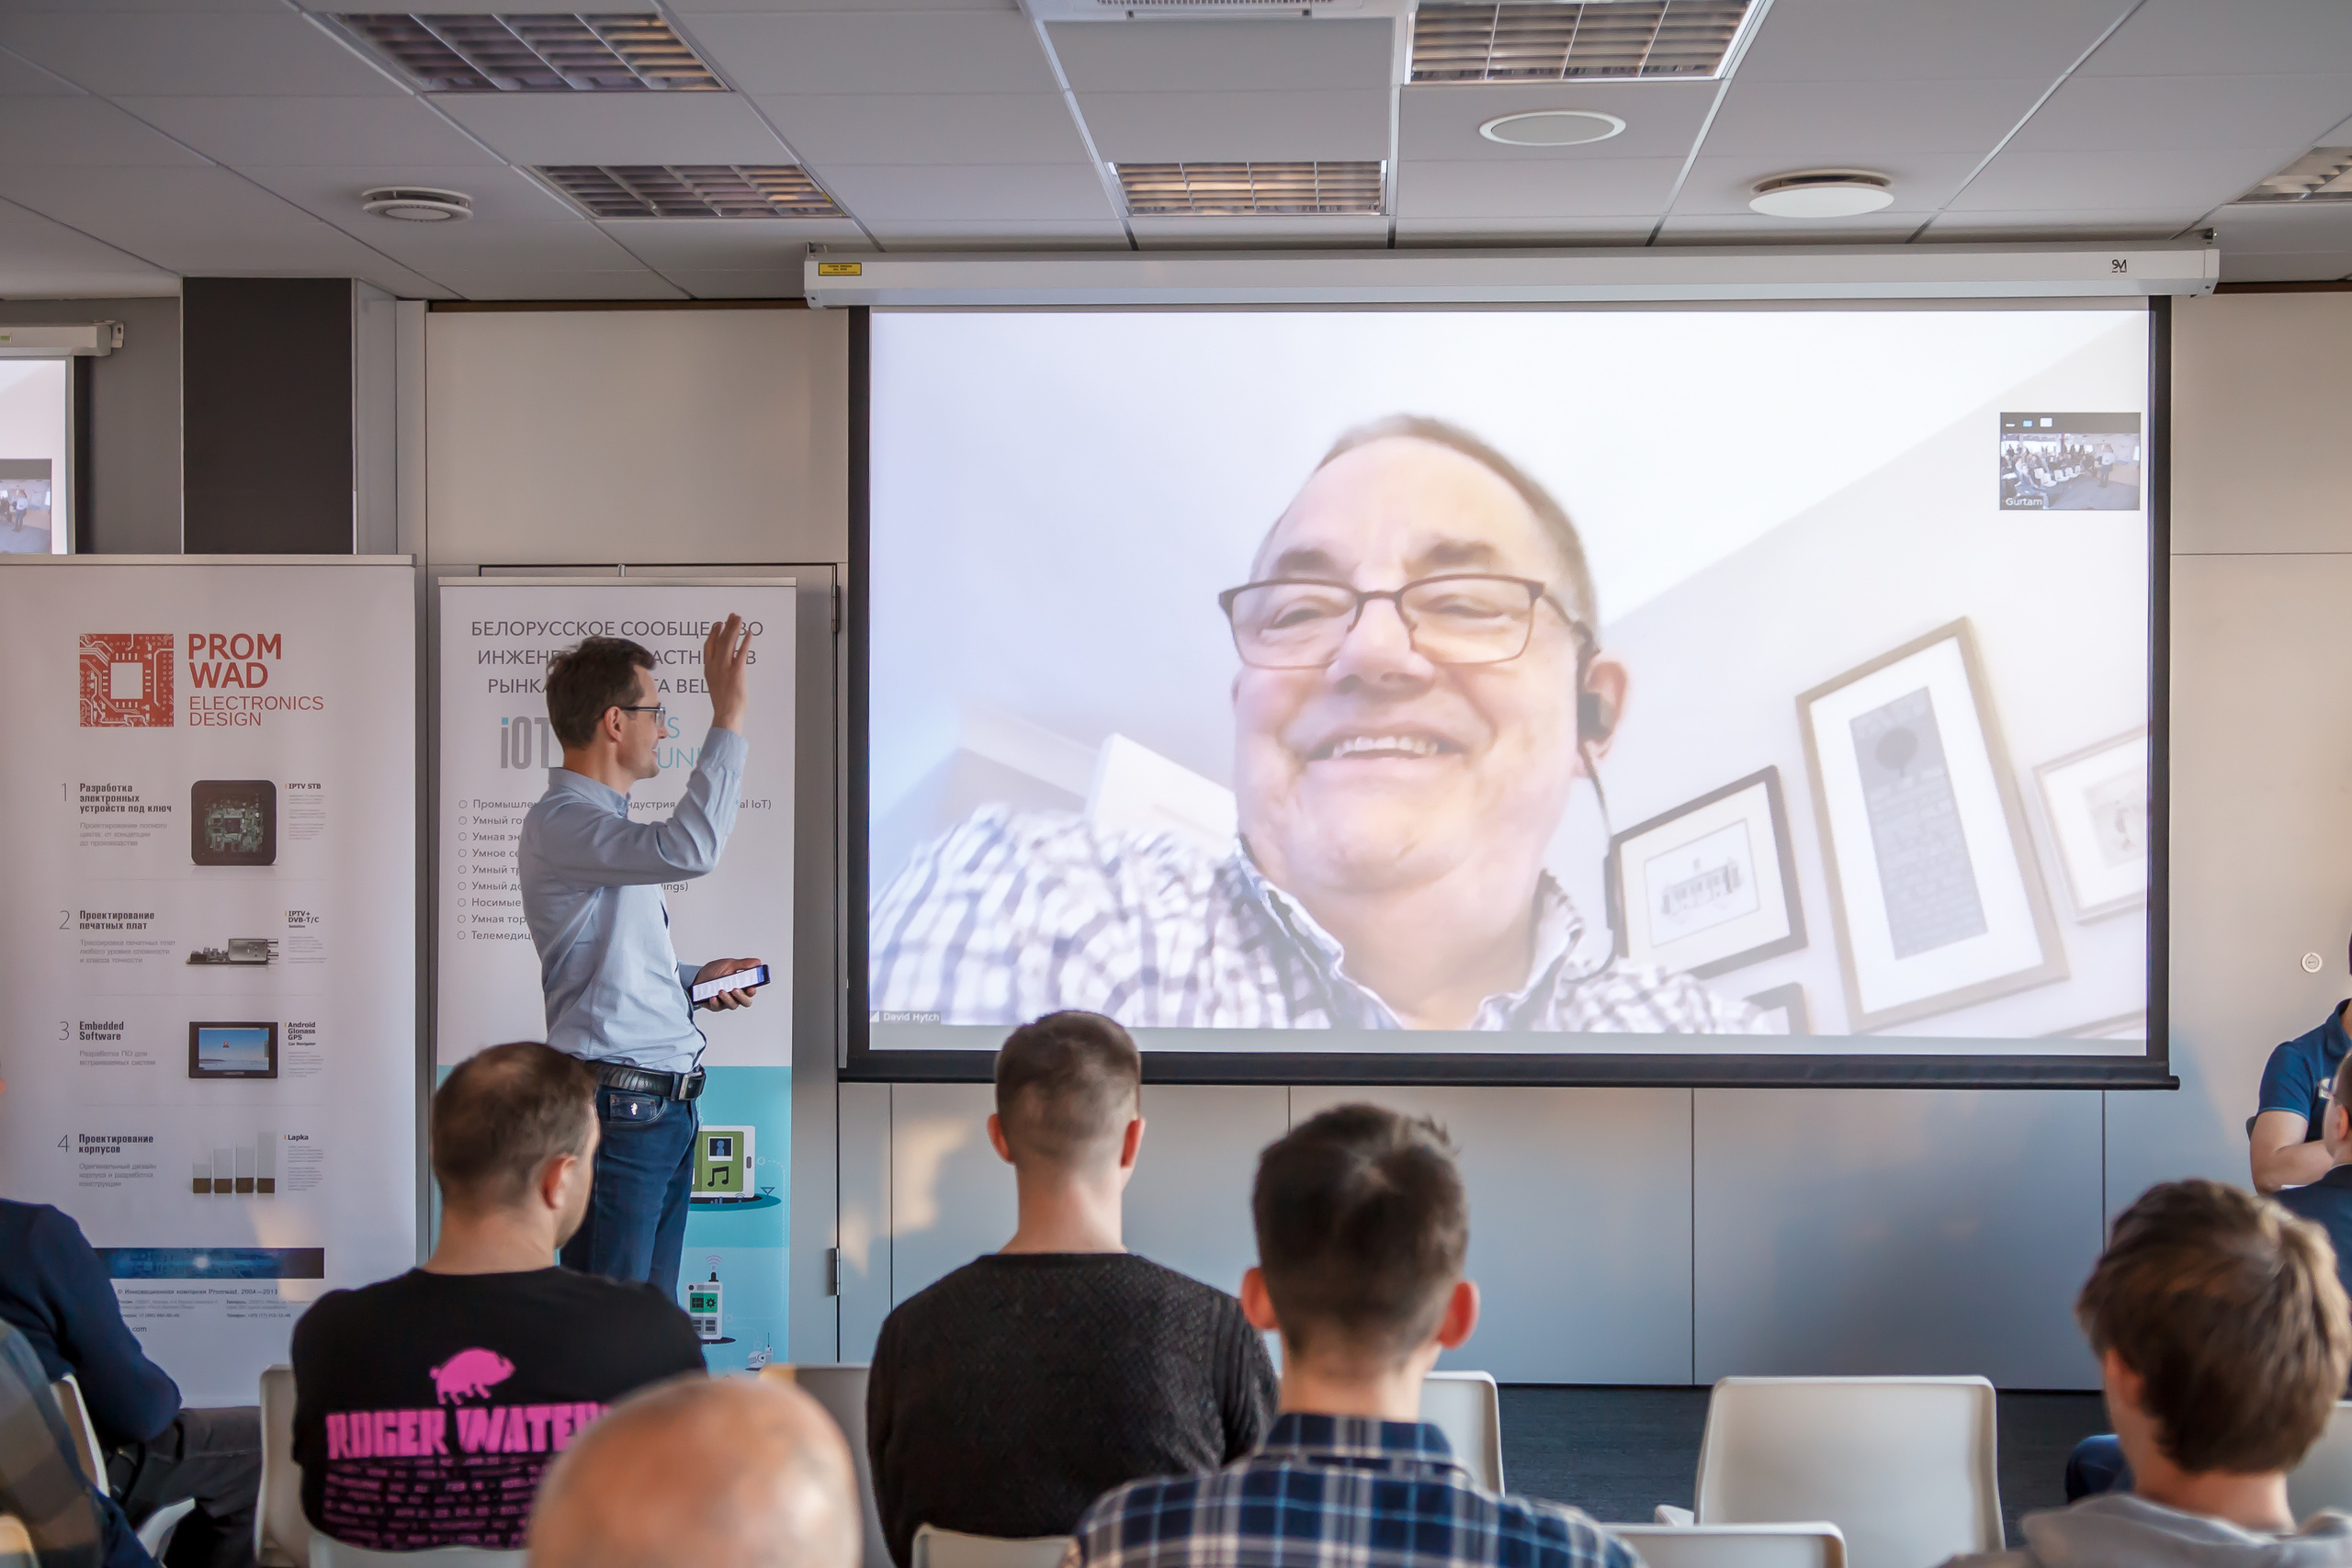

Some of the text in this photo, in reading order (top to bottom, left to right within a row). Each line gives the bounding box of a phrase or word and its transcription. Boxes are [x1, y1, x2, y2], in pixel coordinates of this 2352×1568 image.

[2006, 497, 2042, 506] Gurtam
[471, 621, 763, 638] БЕЛОРУССКОЕ СООБЩЕВО
[188, 633, 281, 660] PROM
[188, 661, 268, 689] WAD
[189, 695, 324, 711] ELECTRONICS
[189, 712, 261, 727] DESIGN
[62, 783, 67, 802] 1
[79, 783, 133, 795] Разработка
[79, 795, 140, 805] электронных
[473, 799, 537, 810] Промышле
[628, 801, 675, 810] ндустрия
[752, 799, 772, 809] IoT)
[79, 804, 126, 815] устройств
[128, 806, 145, 814] под
[472, 816, 508, 825] Умный
[472, 832, 505, 840] Умная
[472, 848, 506, 857] Умное
[471, 864, 507, 874] Умный
[471, 881, 507, 890] Умный
[471, 897, 522, 907] Носимые
[59, 910, 70, 930] 2
[79, 910, 155, 921] Проектирование
[471, 914, 504, 923] Умная
[471, 930, 532, 941] Телемедиц
[883, 1012, 940, 1023] David Hytch
[59, 1021, 70, 1041] 3
[79, 1021, 124, 1030] Embedded
[79, 1031, 121, 1041] Software
[57, 1134, 70, 1153] 4
[78, 1134, 154, 1145] Проектирование
[78, 1145, 120, 1155] корпусов
